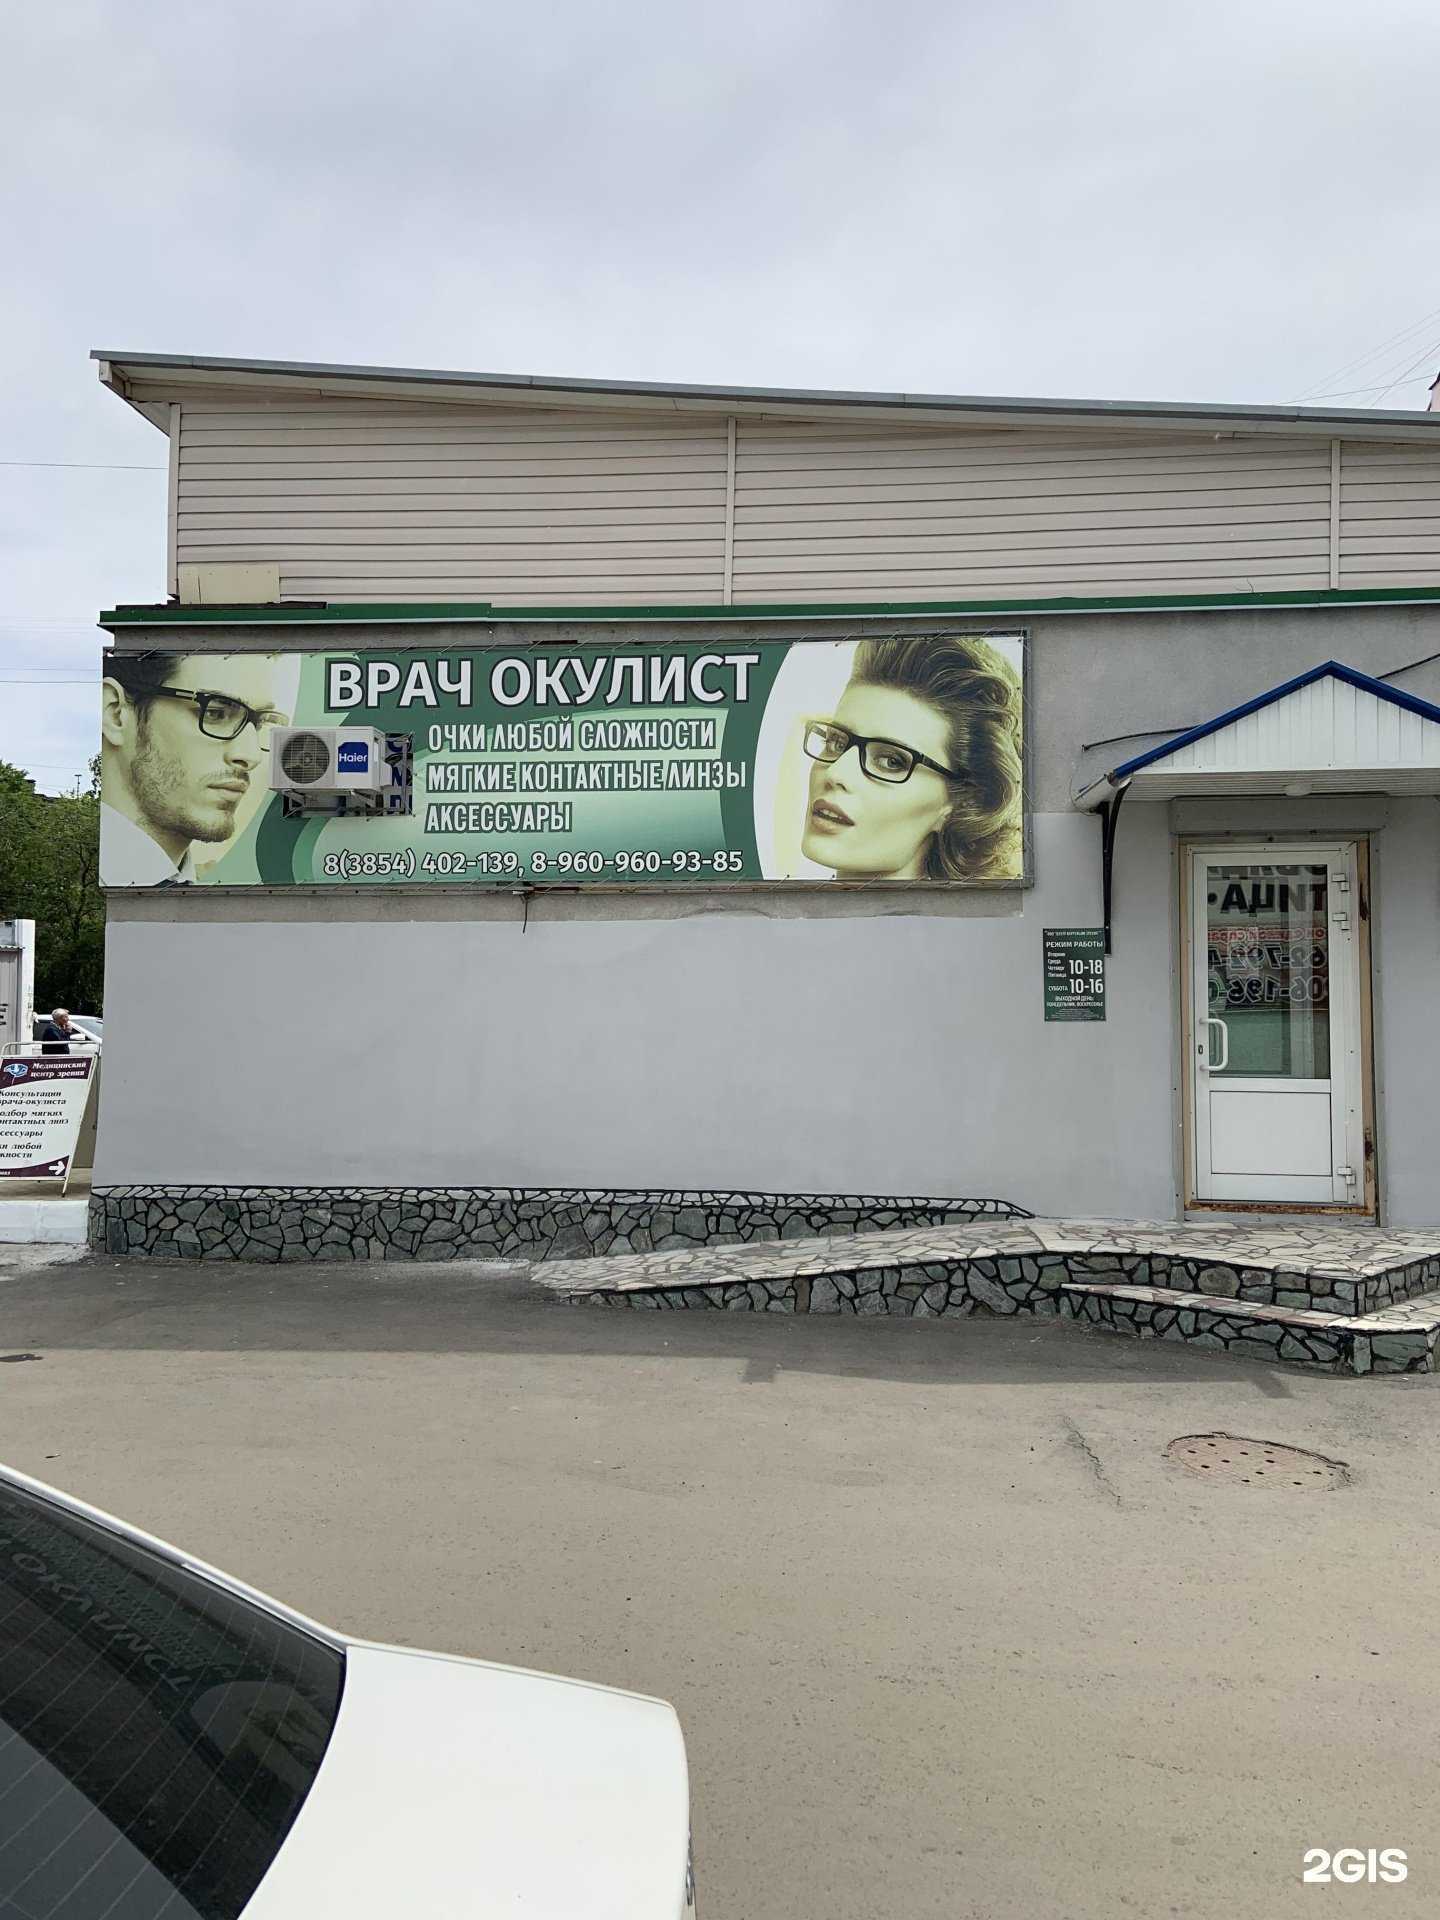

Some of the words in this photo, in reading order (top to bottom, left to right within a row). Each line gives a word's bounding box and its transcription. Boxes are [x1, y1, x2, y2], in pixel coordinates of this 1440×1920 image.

[328, 658, 473, 709] ВРАЧ
[490, 654, 760, 707] ОКУЛИСТ
[428, 723, 486, 750] ОЧКИ
[493, 716, 572, 749] ЛЮБОЙ
[579, 720, 715, 749] СЛОЖНОСТИ
[338, 753, 368, 763] Haier
[428, 764, 515, 791] МЯГКИЕ
[521, 762, 662, 791] КОНТАКТНЫЕ
[668, 761, 746, 789] ЛИНЗЫ
[426, 803, 572, 832] АКСЕССУАРЫ
[323, 850, 416, 878] 8(3854)
[421, 851, 525, 877] 402-139,
[531, 850, 743, 874] 8-960-960-93-85
[1069, 960, 1103, 975] 10-18
[1069, 979, 1104, 994] 10-16
[57, 1070, 85, 1078] зрения
